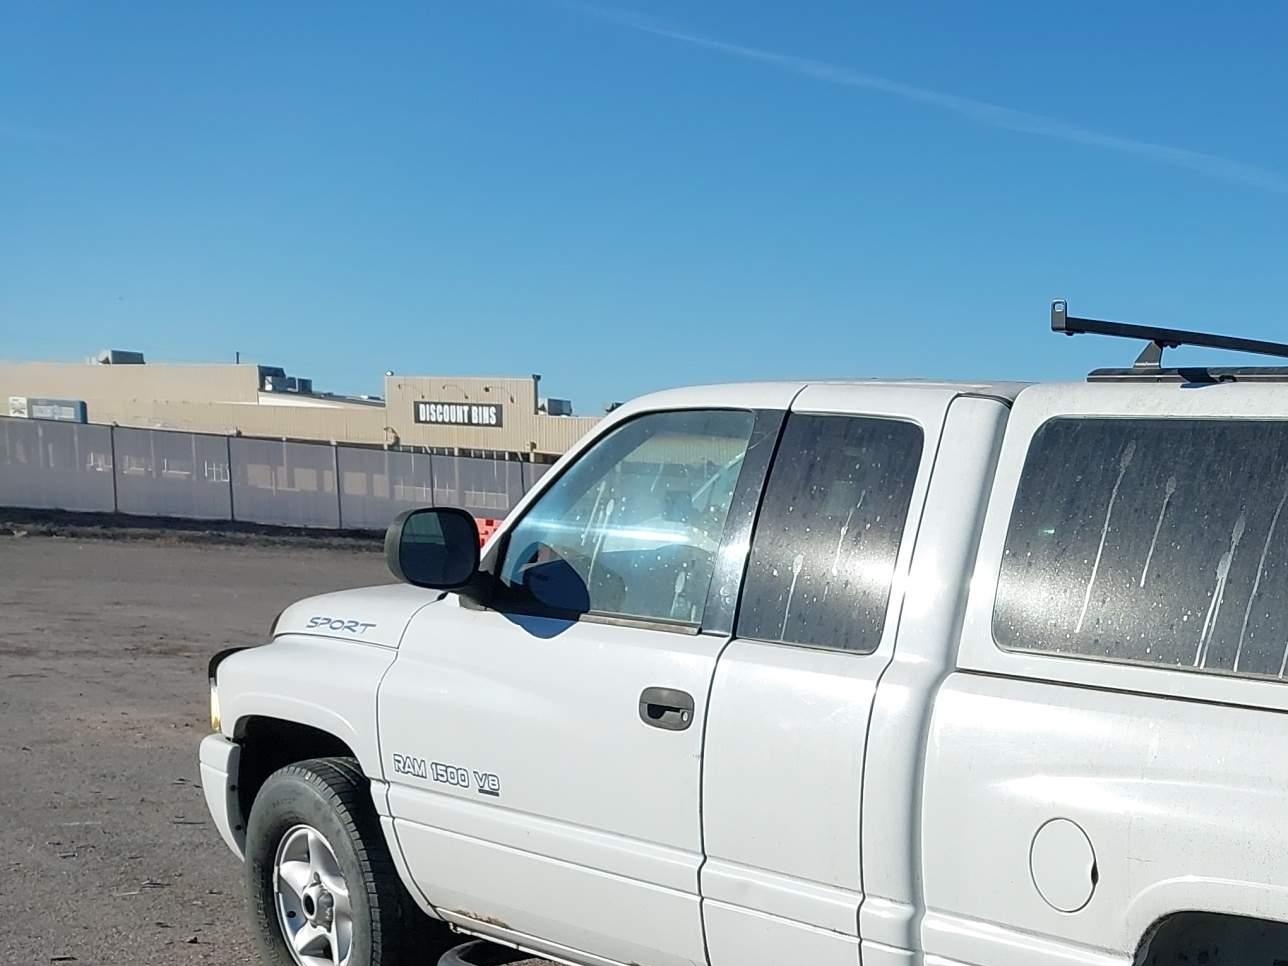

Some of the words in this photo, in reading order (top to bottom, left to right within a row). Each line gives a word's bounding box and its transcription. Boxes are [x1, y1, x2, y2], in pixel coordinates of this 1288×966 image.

[419, 403, 469, 423] DISCOUNT
[471, 405, 497, 425] BINS
[306, 616, 377, 634] SPORT
[393, 753, 427, 779] RAM
[431, 762, 469, 788] 1500
[473, 771, 500, 792] V8
